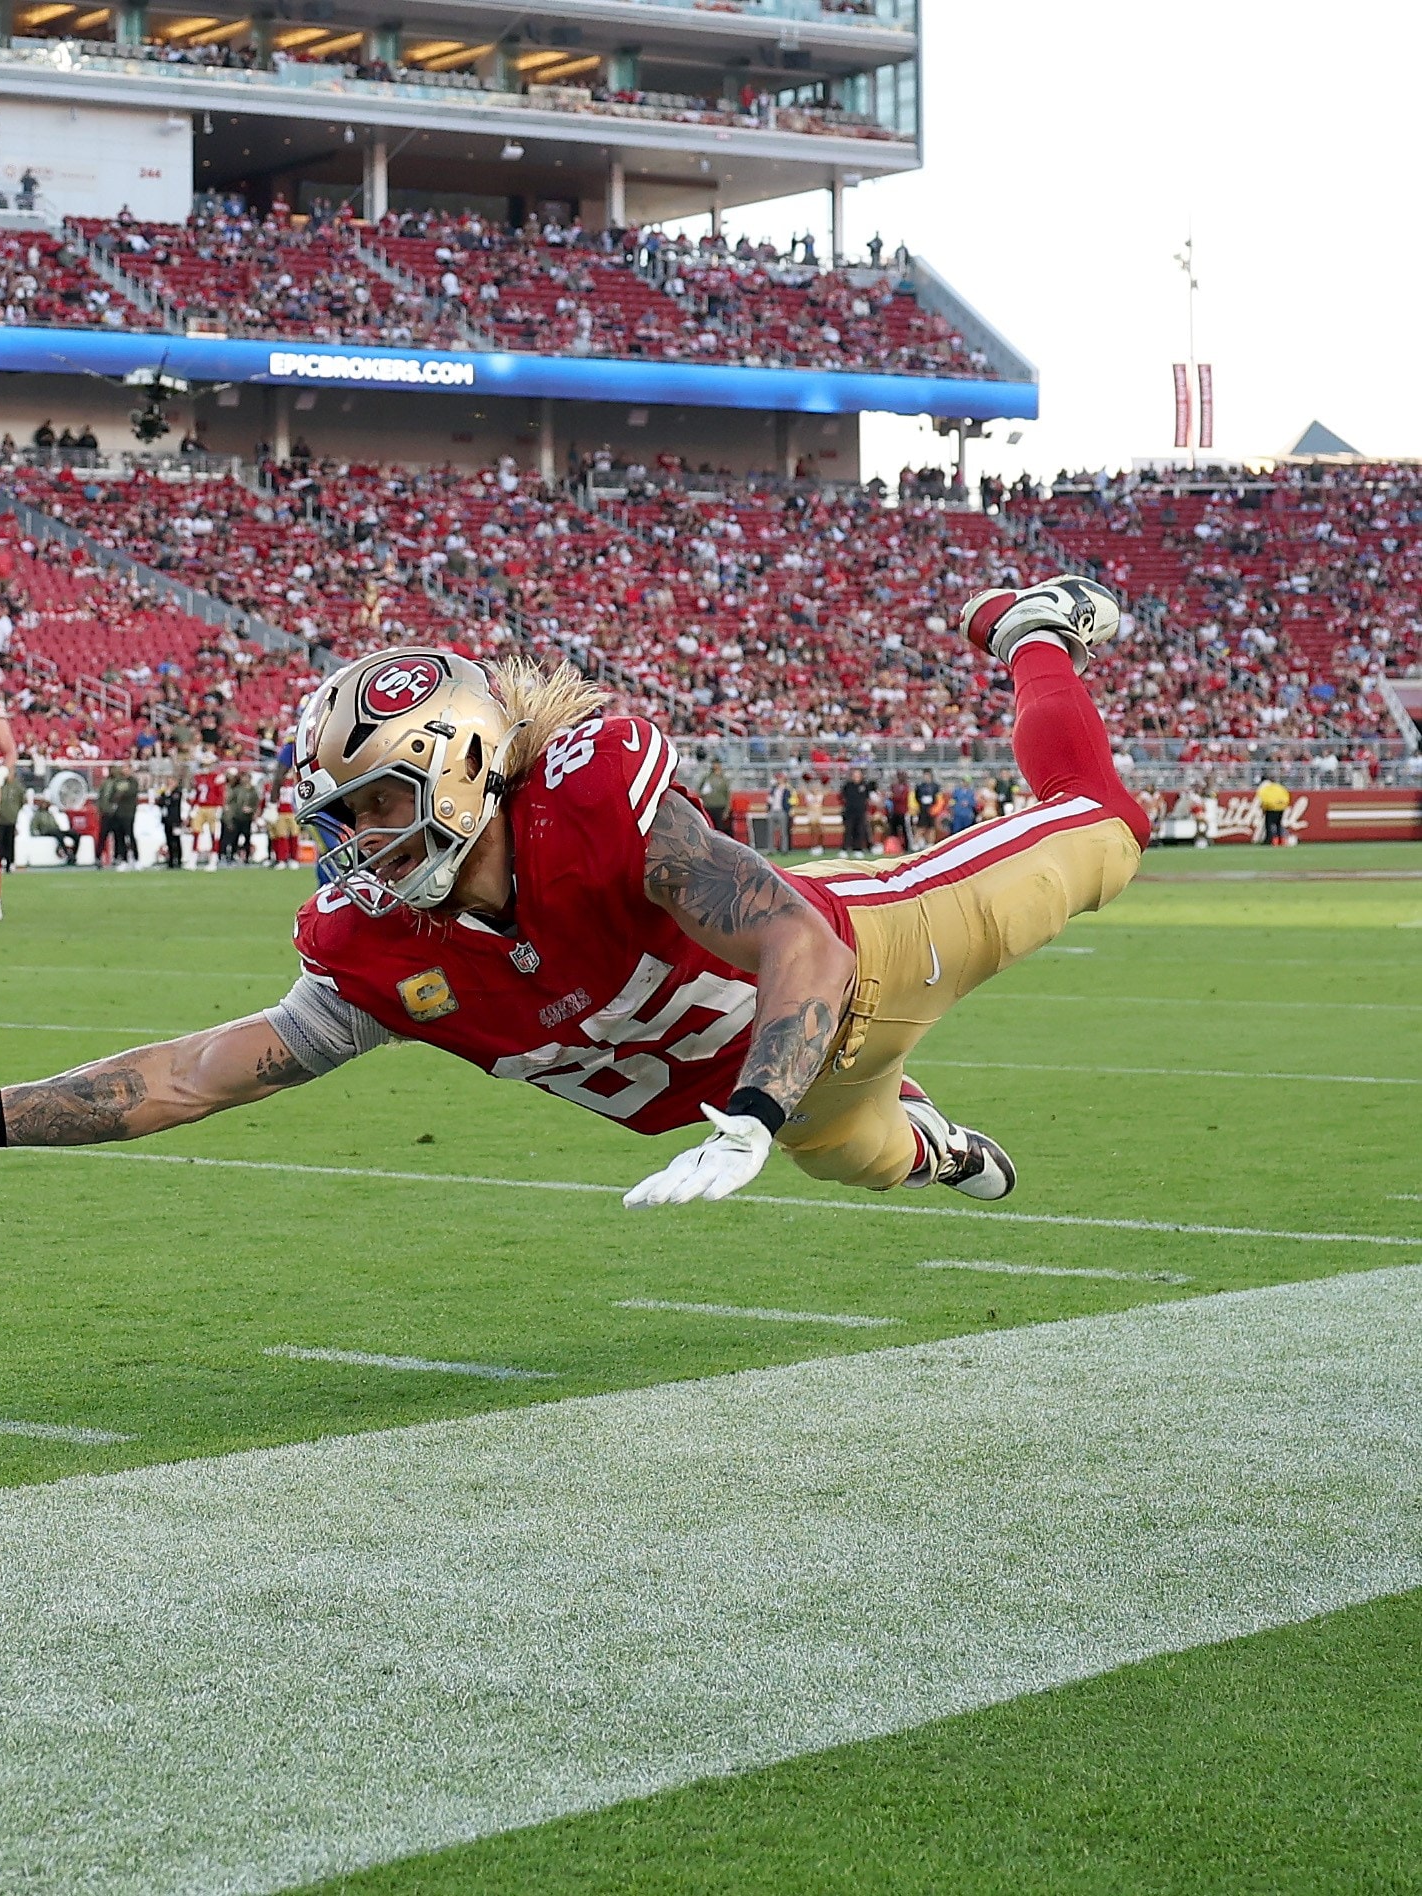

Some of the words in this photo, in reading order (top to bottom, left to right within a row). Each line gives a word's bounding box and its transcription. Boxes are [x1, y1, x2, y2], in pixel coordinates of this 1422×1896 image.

[269, 352, 474, 386] EPICBROKERS.COM
[403, 971, 451, 1012] C
[491, 952, 758, 1119] 85
